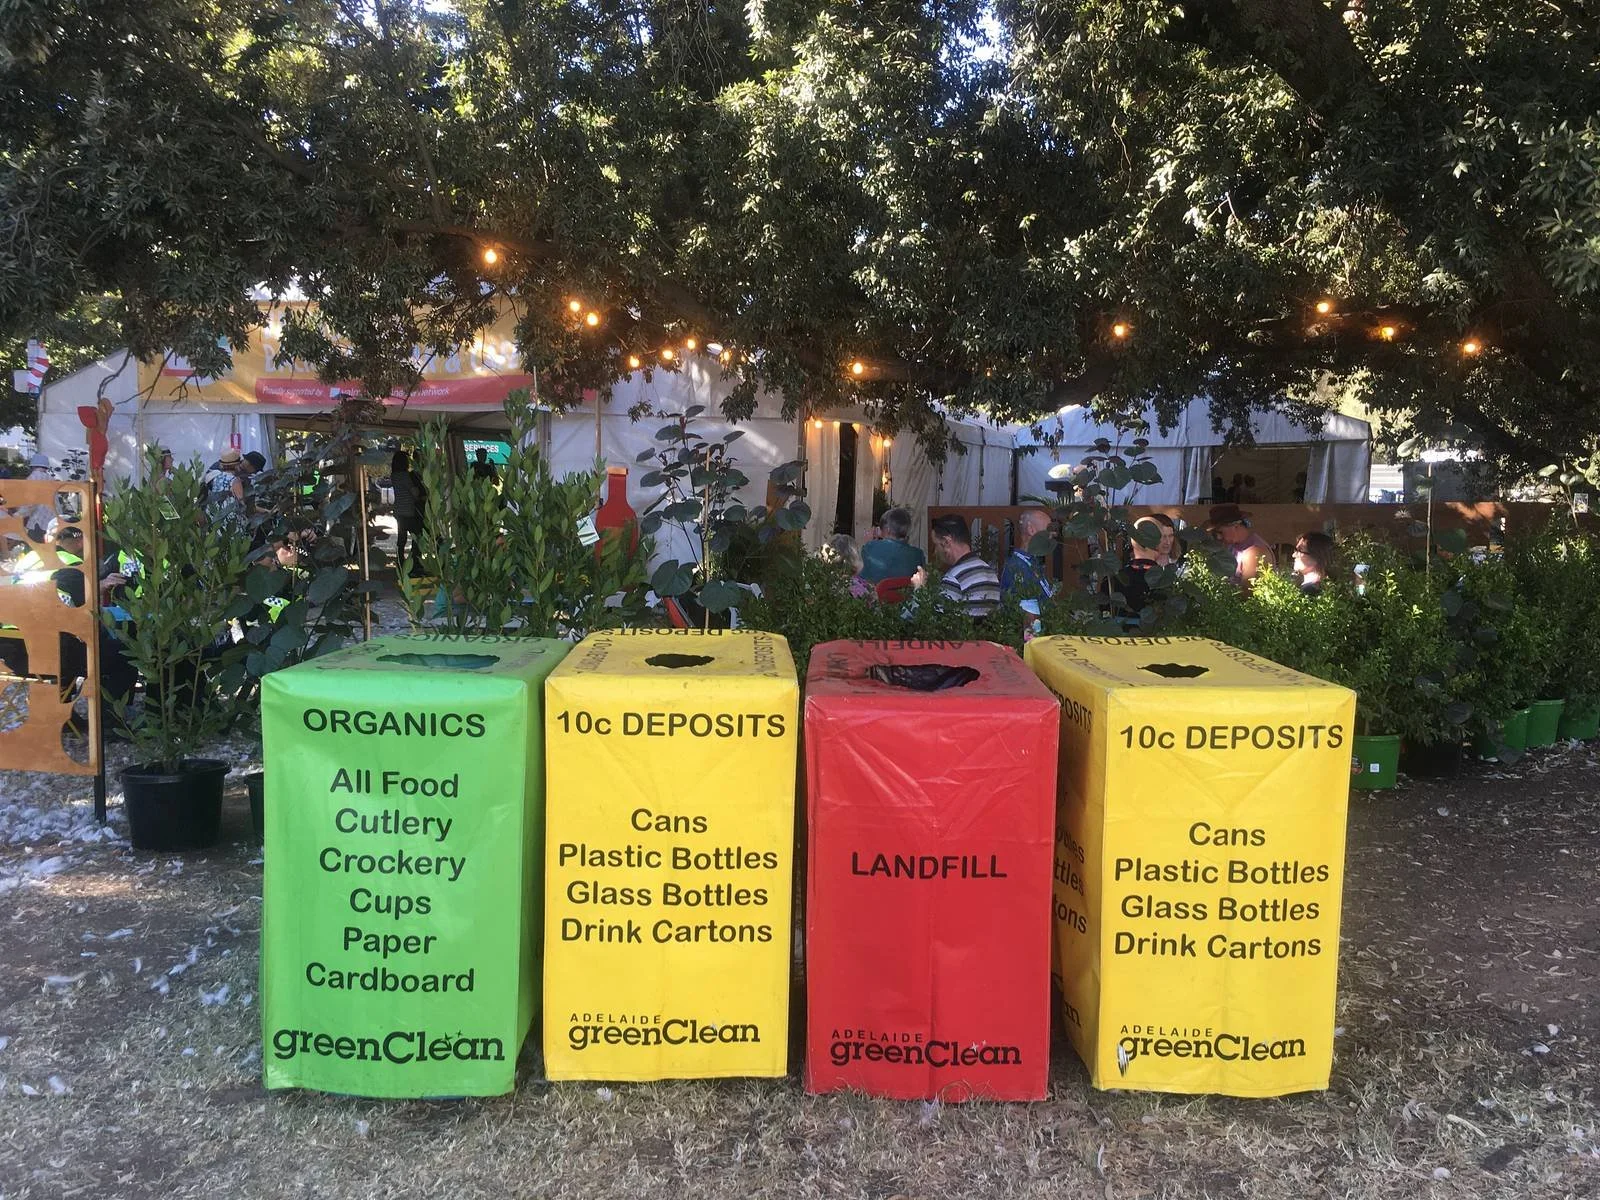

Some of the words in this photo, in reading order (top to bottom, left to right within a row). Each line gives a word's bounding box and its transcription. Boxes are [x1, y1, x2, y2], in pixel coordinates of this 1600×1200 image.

[601, 628, 723, 637] DEPOSITS
[303, 709, 485, 737] ORGANICS
[557, 711, 611, 735] 10c
[623, 713, 785, 737] DEPOSITS
[1119, 726, 1174, 749] 10c
[1187, 725, 1343, 749] DEPOSITS
[330, 768, 370, 793] All
[383, 772, 458, 798] Food
[336, 808, 452, 842] Cutlery
[632, 809, 707, 833] Cans
[1190, 822, 1265, 846] Cans
[320, 848, 465, 881] Crockery
[560, 844, 661, 868] Plastic
[673, 847, 777, 870] Bottles
[852, 852, 1007, 879] LANDFILL
[1115, 858, 1218, 883] Plastic
[1228, 860, 1328, 884] Bottles
[350, 888, 431, 920] Cups
[567, 881, 651, 906] Glass
[663, 883, 768, 906] Bottles
[1122, 895, 1207, 920] Glass
[1219, 897, 1319, 922] Bottles
[344, 927, 437, 959] Paper
[562, 919, 641, 943] Drink
[653, 920, 772, 943] Cartons
[1115, 932, 1196, 957] Drink
[1208, 935, 1321, 959] Cartons
[306, 962, 474, 992] Cardboard
[570, 1013, 661, 1023] ADELAIDE
[1120, 1025, 1212, 1037] ADELAIDE
[273, 1030, 505, 1064] greenClean
[569, 1020, 760, 1050] greenClean
[832, 1030, 921, 1042] ADELAIDE
[831, 1041, 1021, 1068] greenClean
[1118, 1034, 1306, 1064] greenClean
